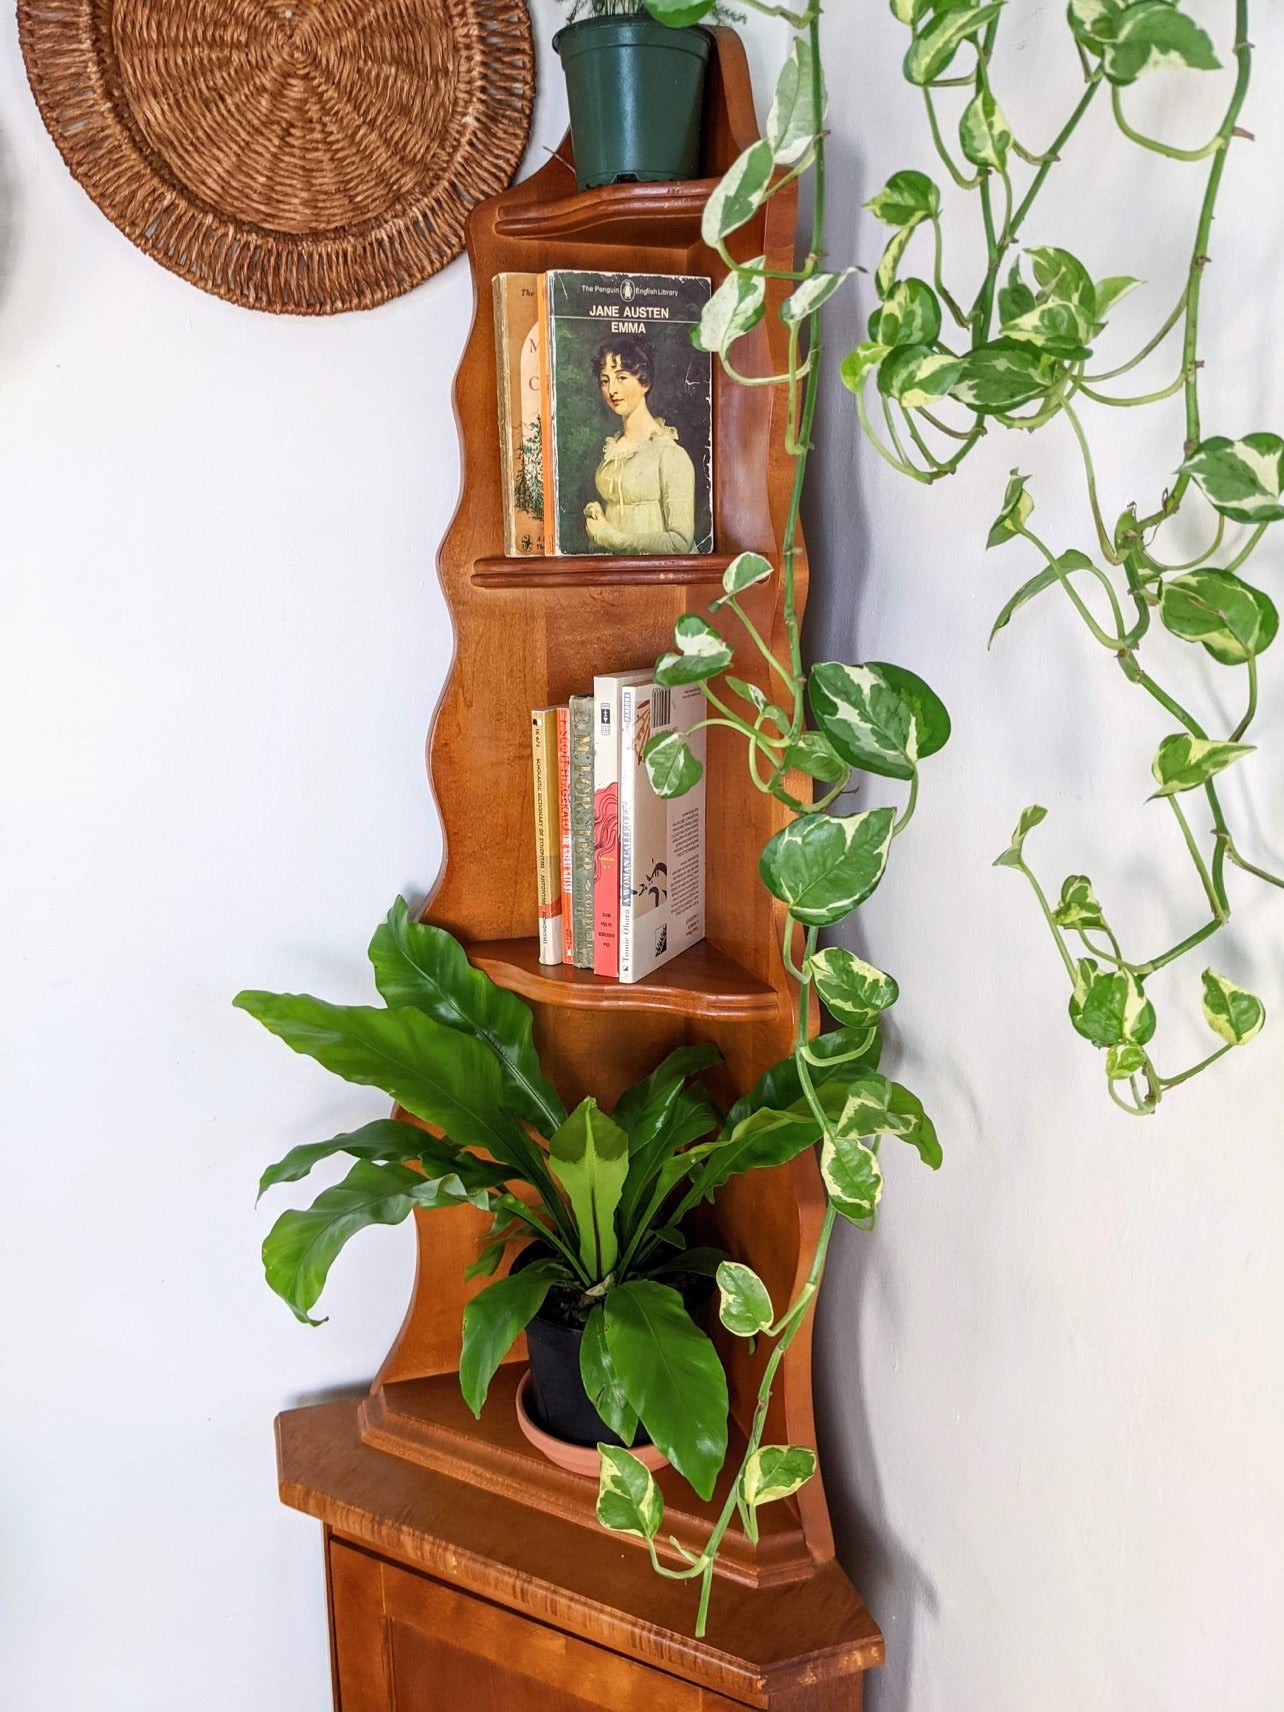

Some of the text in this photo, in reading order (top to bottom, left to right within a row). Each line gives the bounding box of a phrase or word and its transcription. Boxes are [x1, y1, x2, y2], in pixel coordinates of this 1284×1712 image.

[520, 289, 535, 297] The
[582, 285, 679, 297] The Penguin English Library
[589, 304, 669, 319] JANE AUSTEN
[611, 321, 647, 334] EMMA
[574, 763, 592, 870] FORSTER
[538, 828, 544, 836] OF
[562, 834, 571, 845] THE
[562, 847, 572, 867] GREAT
[563, 870, 572, 894] GATSBY
[623, 860, 631, 896] WOMAN
[622, 937, 630, 962] Tomie
